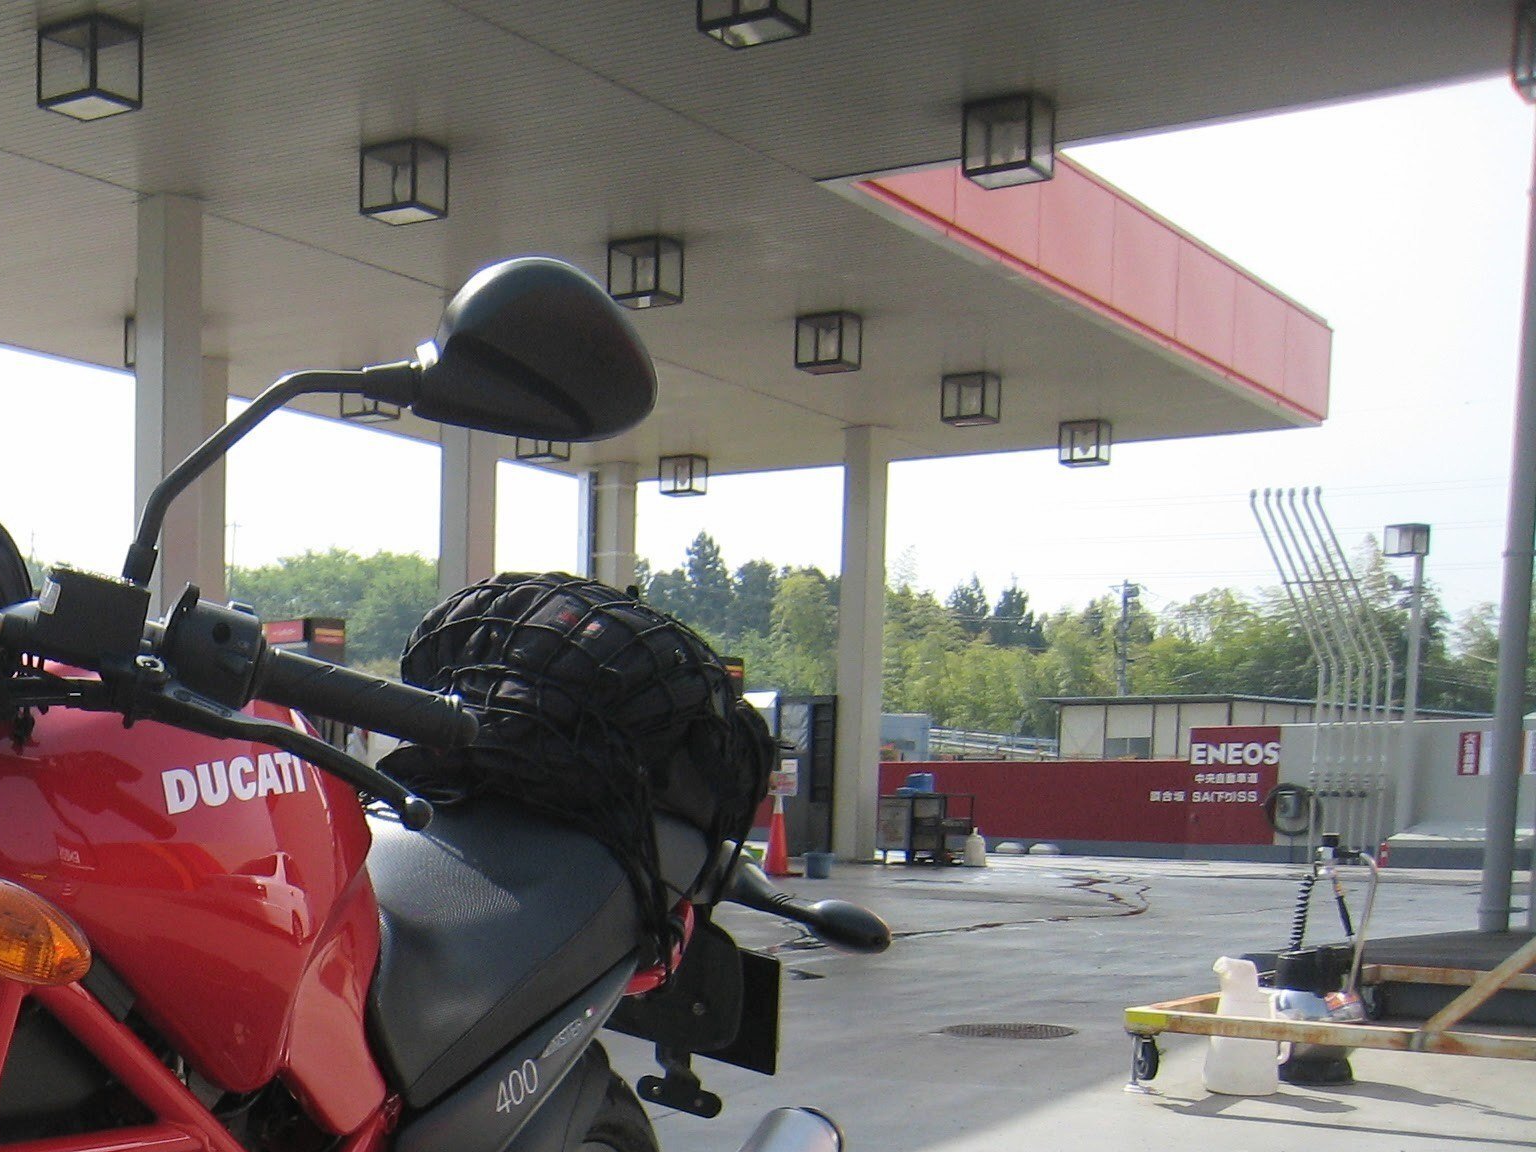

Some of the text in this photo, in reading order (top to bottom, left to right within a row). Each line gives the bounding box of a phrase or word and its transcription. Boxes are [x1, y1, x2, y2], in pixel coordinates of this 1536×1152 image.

[1190, 741, 1281, 766] ENEOS
[161, 751, 306, 815] DUCATI
[495, 1059, 538, 1114] 400
